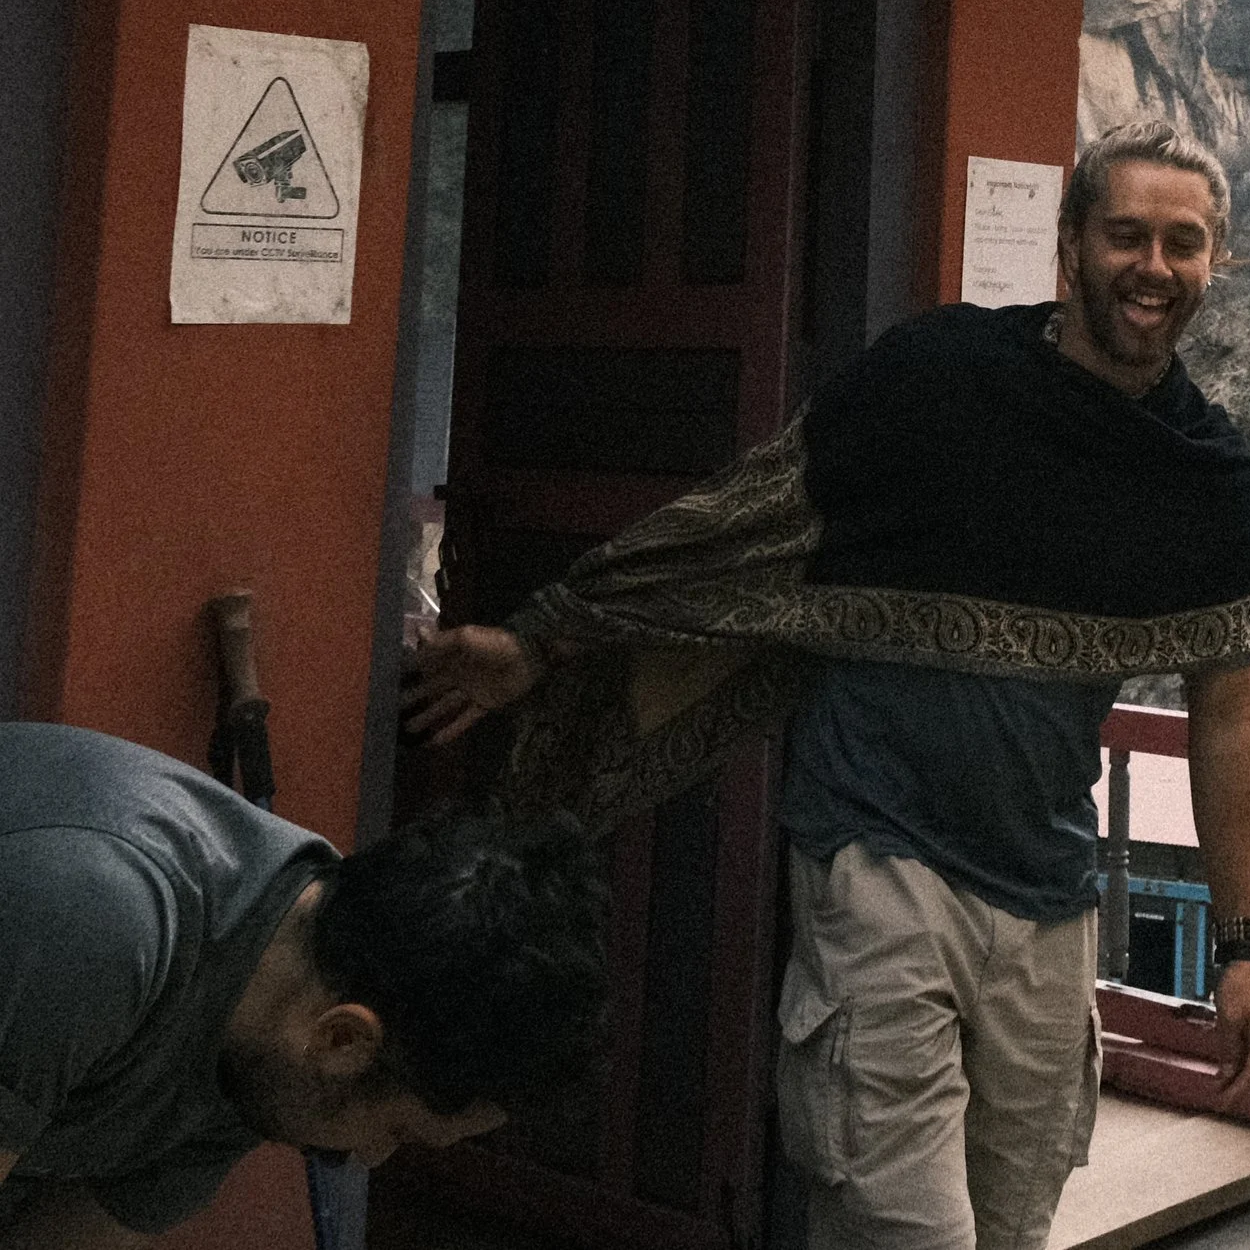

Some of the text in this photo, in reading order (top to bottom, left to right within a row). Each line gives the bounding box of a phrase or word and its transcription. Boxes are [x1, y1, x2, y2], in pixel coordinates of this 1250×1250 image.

[241, 230, 297, 244] NOTICE
[232, 248, 258, 257] under
[261, 248, 285, 258] CCTV
